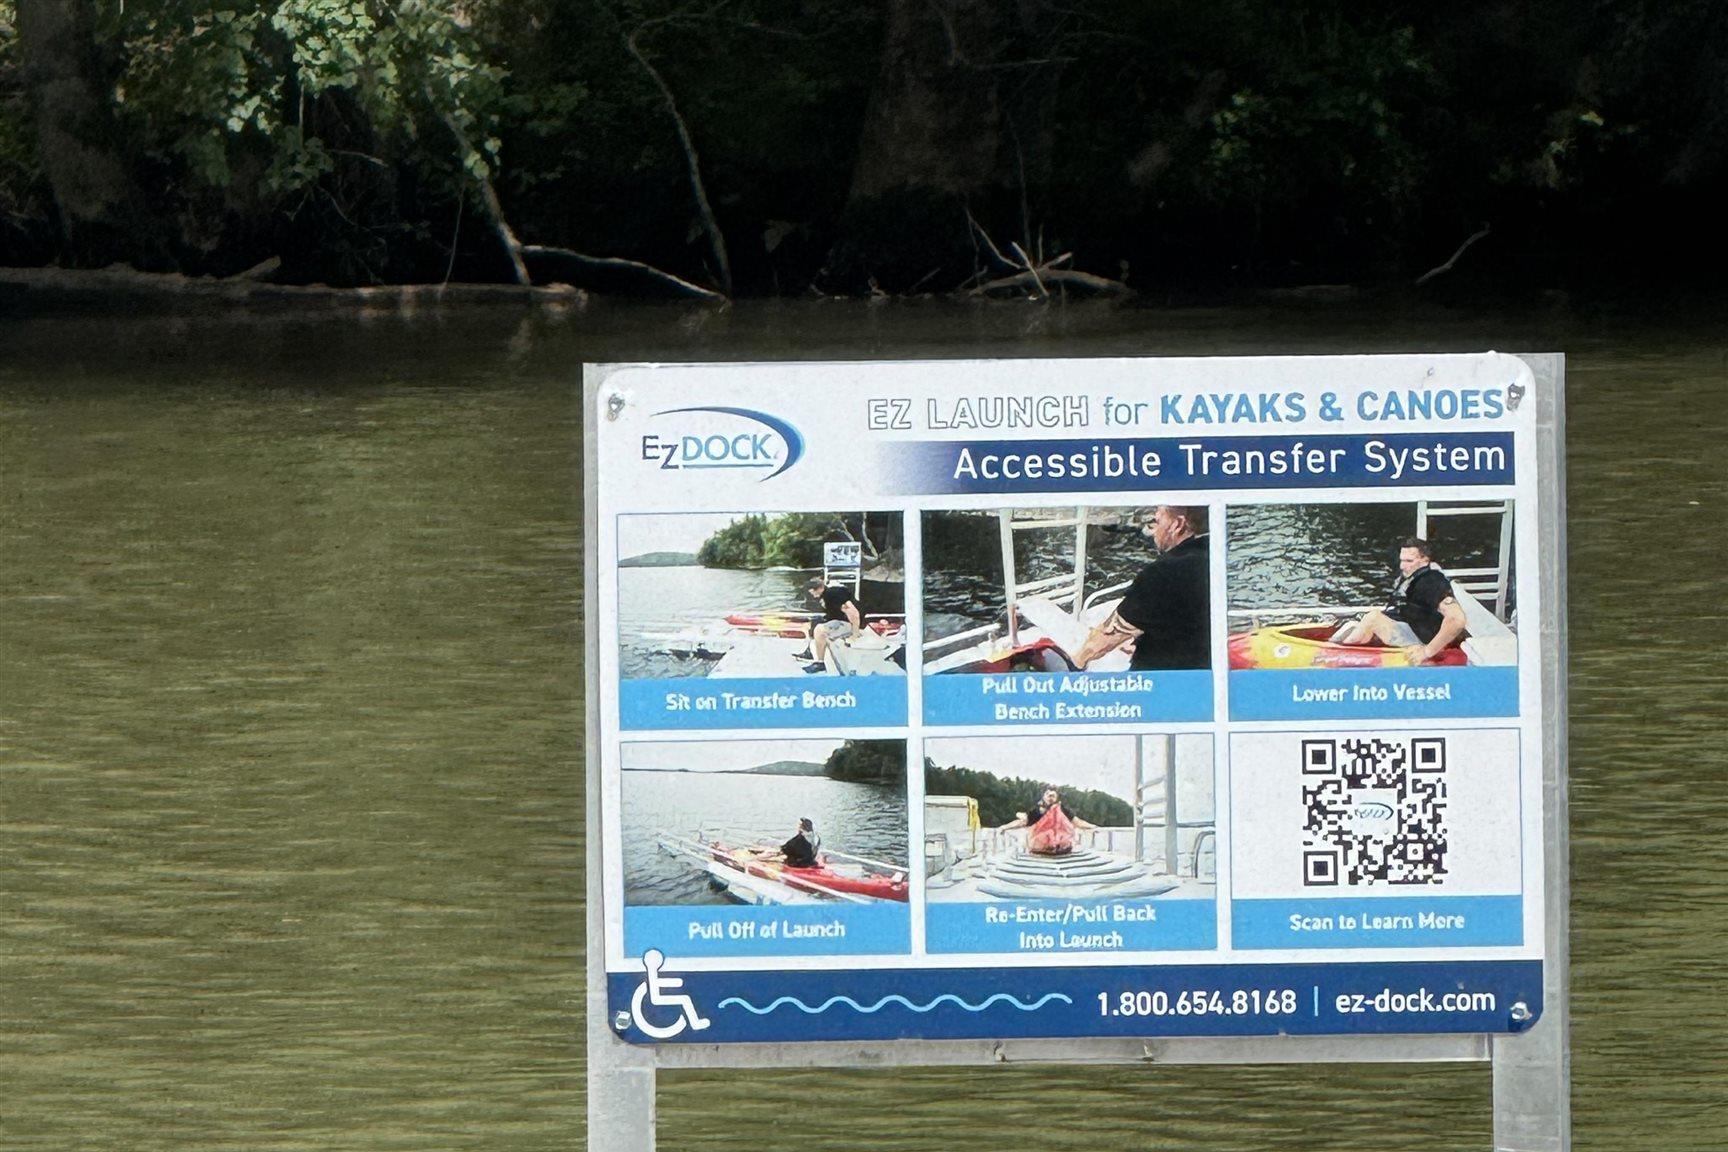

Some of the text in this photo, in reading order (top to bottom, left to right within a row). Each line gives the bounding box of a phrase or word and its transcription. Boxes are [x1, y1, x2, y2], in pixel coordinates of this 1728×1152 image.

[868, 388, 1504, 431] EZ LAUNCH for KAYAKS & CANOES
[953, 440, 1506, 480] Accessible Transfer System
[982, 674, 1154, 697] Pull Out Adjustable
[1292, 683, 1451, 702] Lower Into Vessel
[665, 690, 857, 711] Sit on Transfer Bench
[994, 701, 1142, 721] Bench Extension
[985, 903, 1157, 925] Re-Enter/Pull Back
[1289, 912, 1465, 931] Scan to Learn More
[688, 920, 846, 940] Pull Off of Launch
[1019, 930, 1124, 949] Into Launch
[1097, 987, 1496, 1018] 1.800.654.8168 ez-dock.com
